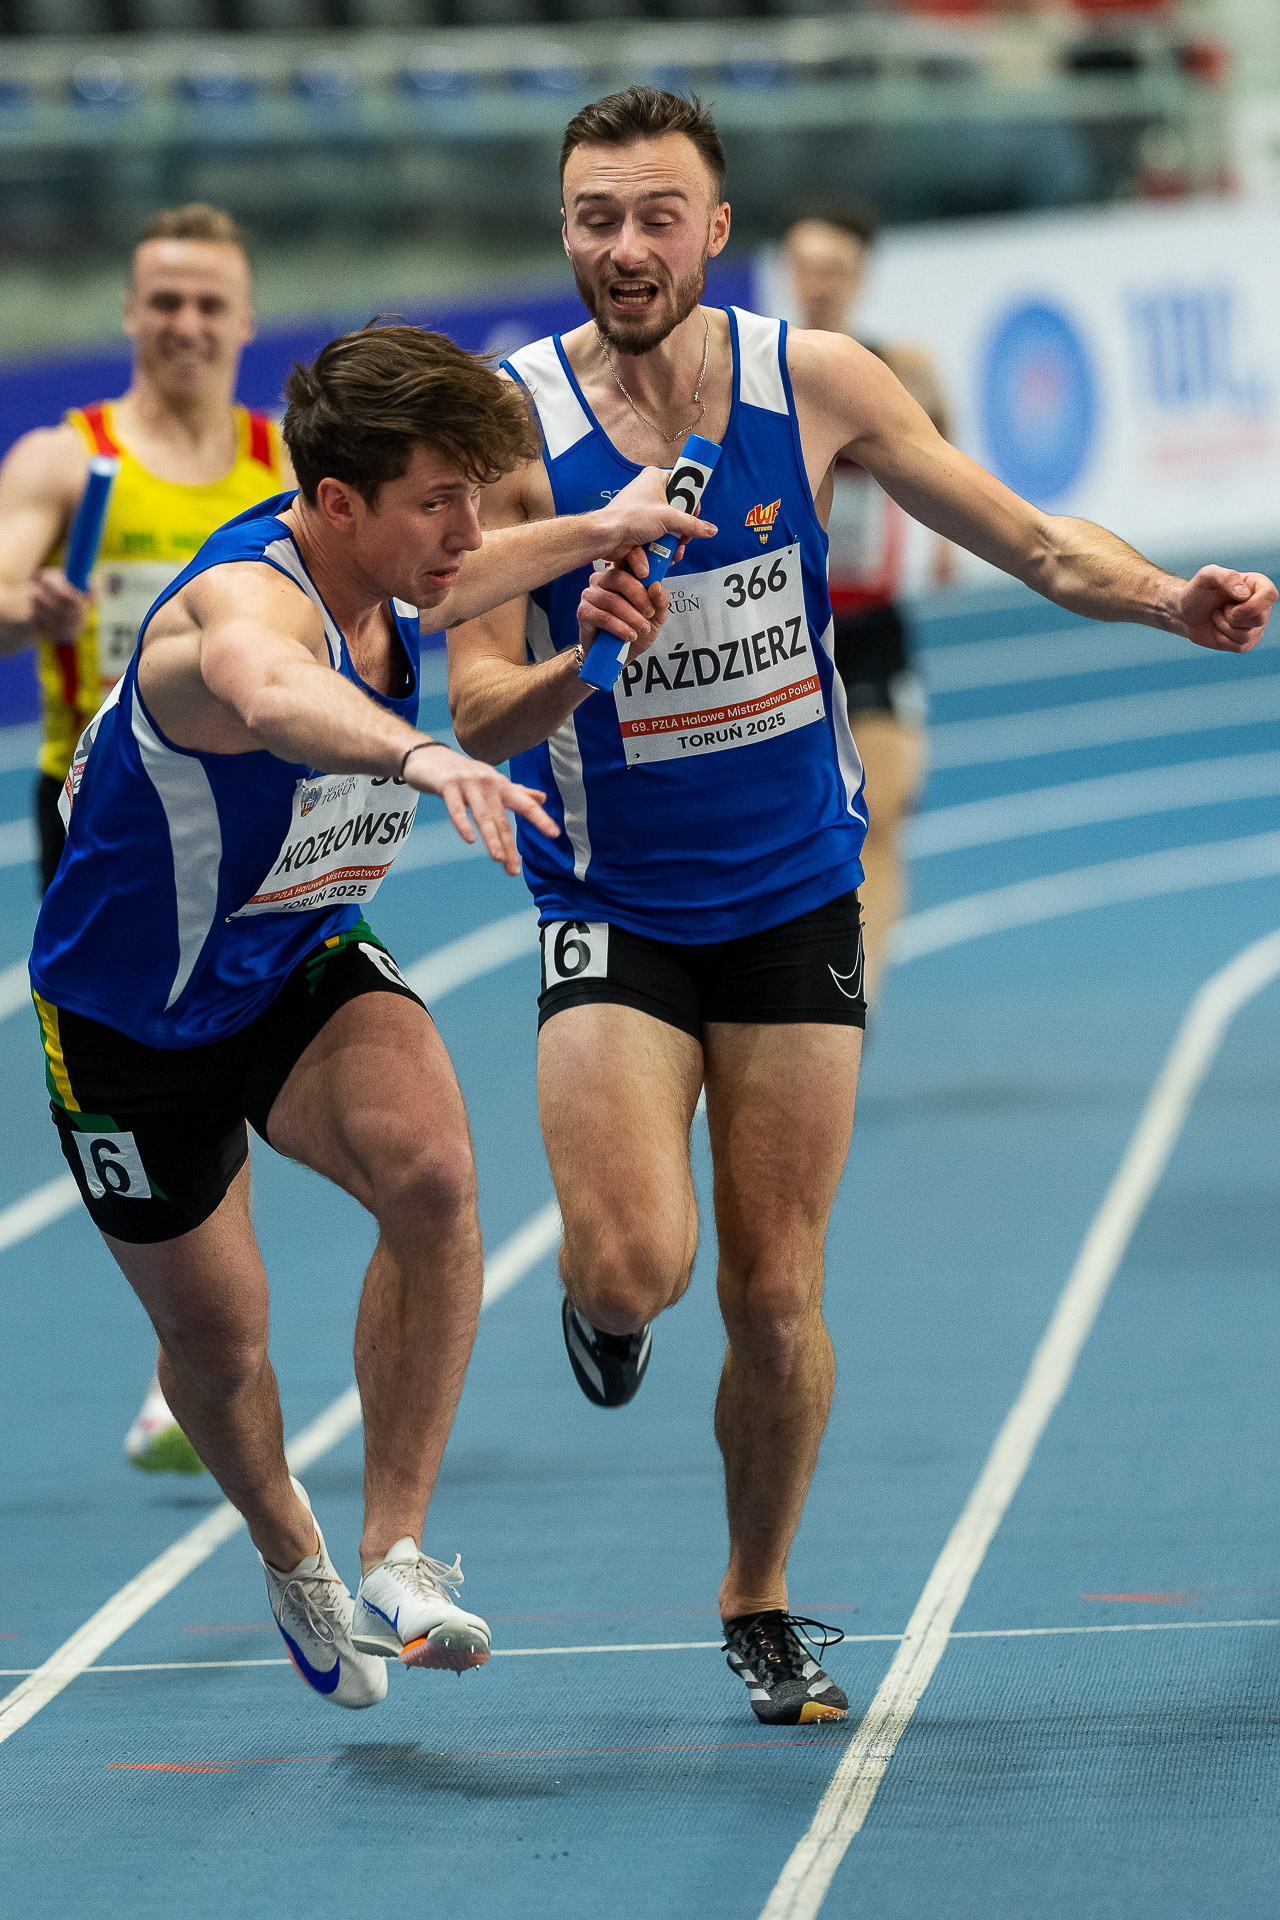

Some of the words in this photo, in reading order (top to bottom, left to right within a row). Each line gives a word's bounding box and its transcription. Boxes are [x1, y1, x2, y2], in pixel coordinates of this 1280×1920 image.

[666, 466, 705, 516] 6
[745, 499, 782, 527] AWF
[668, 594, 700, 613] RUŃ
[723, 557, 788, 608] 366
[621, 615, 807, 697] PAŹDZIERZ
[631, 722, 650, 733] 69.
[652, 718, 679, 731] PZLA
[681, 710, 725, 727] Halowe
[727, 692, 787, 718] Mistrzostwa
[788, 679, 816, 698] Polski
[677, 722, 743, 749] TORUŃ
[746, 712, 786, 737] 2025
[274, 805, 417, 876] KOZŁOWSKI
[281, 886, 327, 910] TORUŃ
[327, 885, 368, 899] 2025
[324, 867, 380, 883] Mistrzostwa
[554, 920, 591, 978] 6
[90, 1138, 131, 1193] 6
